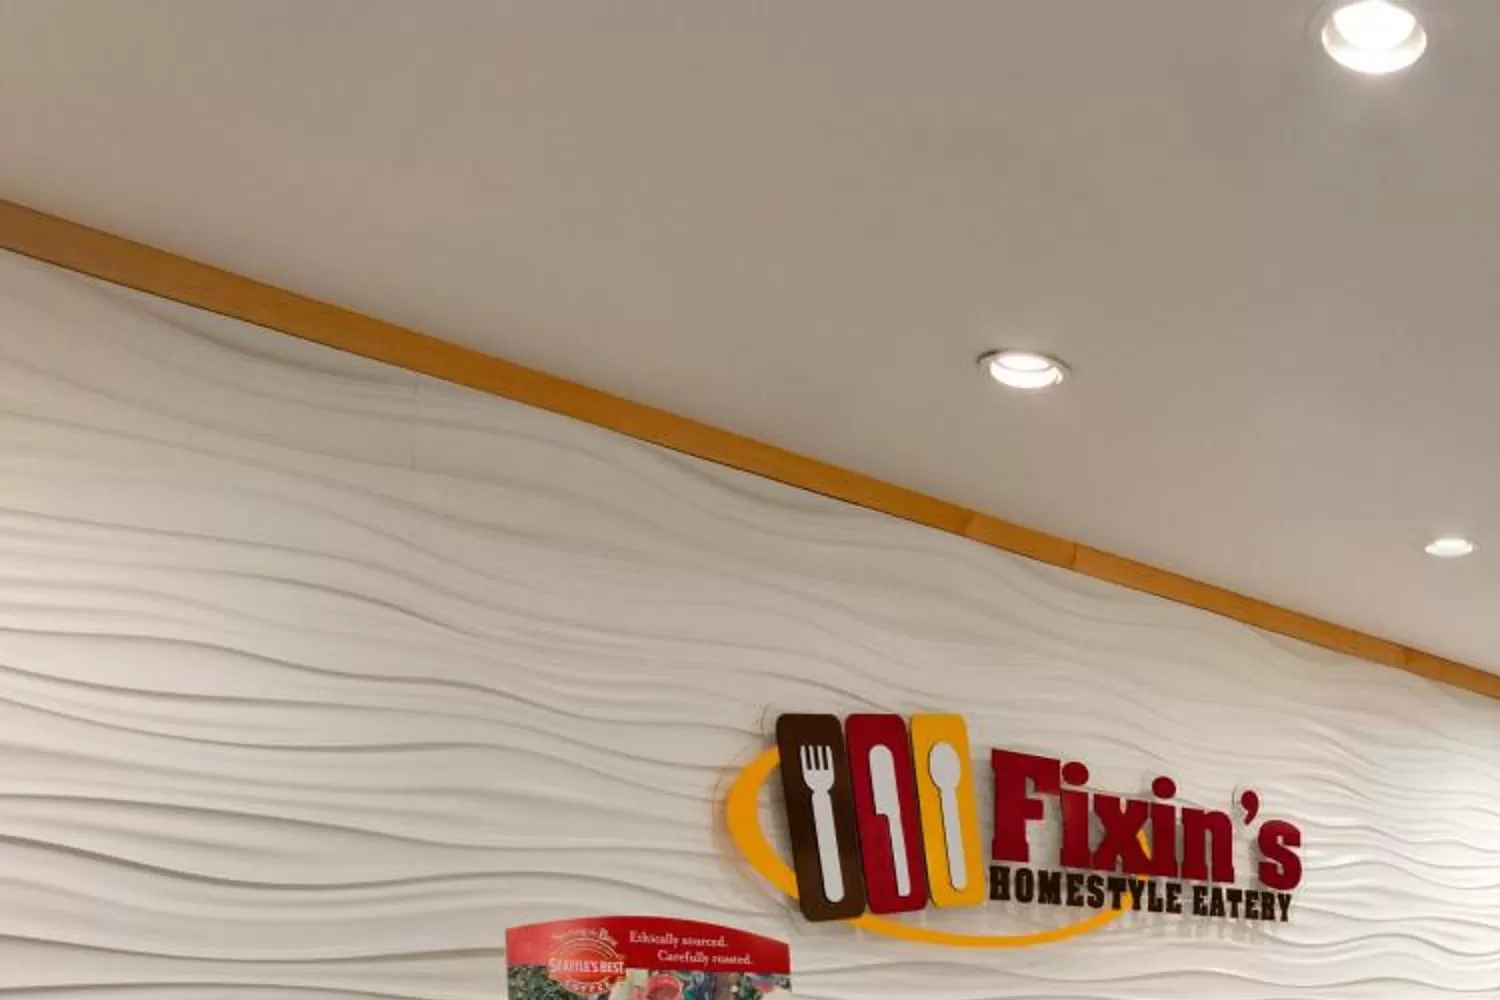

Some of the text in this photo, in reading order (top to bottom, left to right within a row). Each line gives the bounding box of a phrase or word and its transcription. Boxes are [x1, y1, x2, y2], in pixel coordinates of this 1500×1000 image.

[990, 748, 1303, 891] Fixin's
[989, 865, 1293, 922] HOMESTYLE EATERY
[629, 930, 678, 948] Ethically
[657, 949, 709, 968] Carefully
